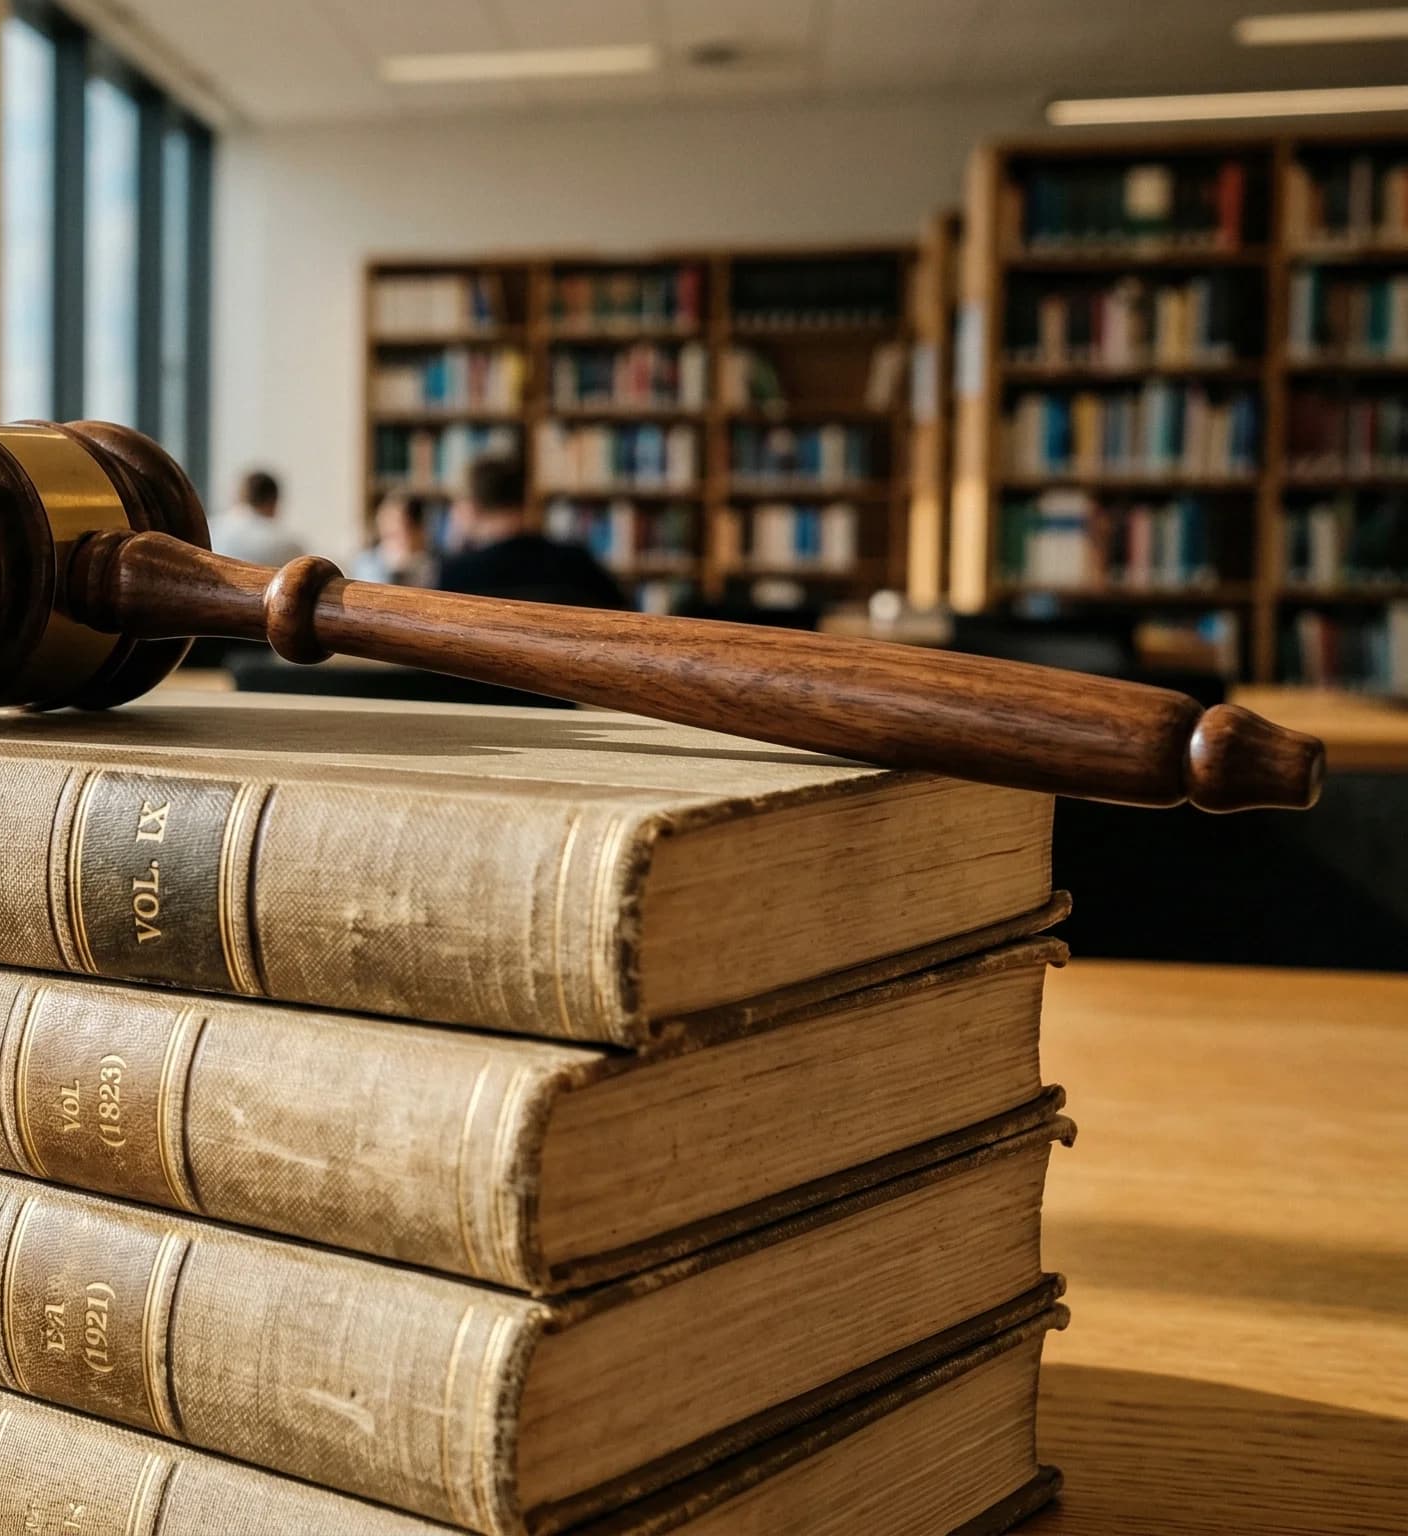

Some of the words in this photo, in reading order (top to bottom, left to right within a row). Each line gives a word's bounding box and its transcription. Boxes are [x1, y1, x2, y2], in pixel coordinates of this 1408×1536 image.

[136, 801, 171, 843] IX
[133, 860, 161, 944] VOL.
[61, 1079, 81, 1132] VOL
[99, 1055, 127, 1147] (1823)
[83, 1282, 116, 1373] (1921)
